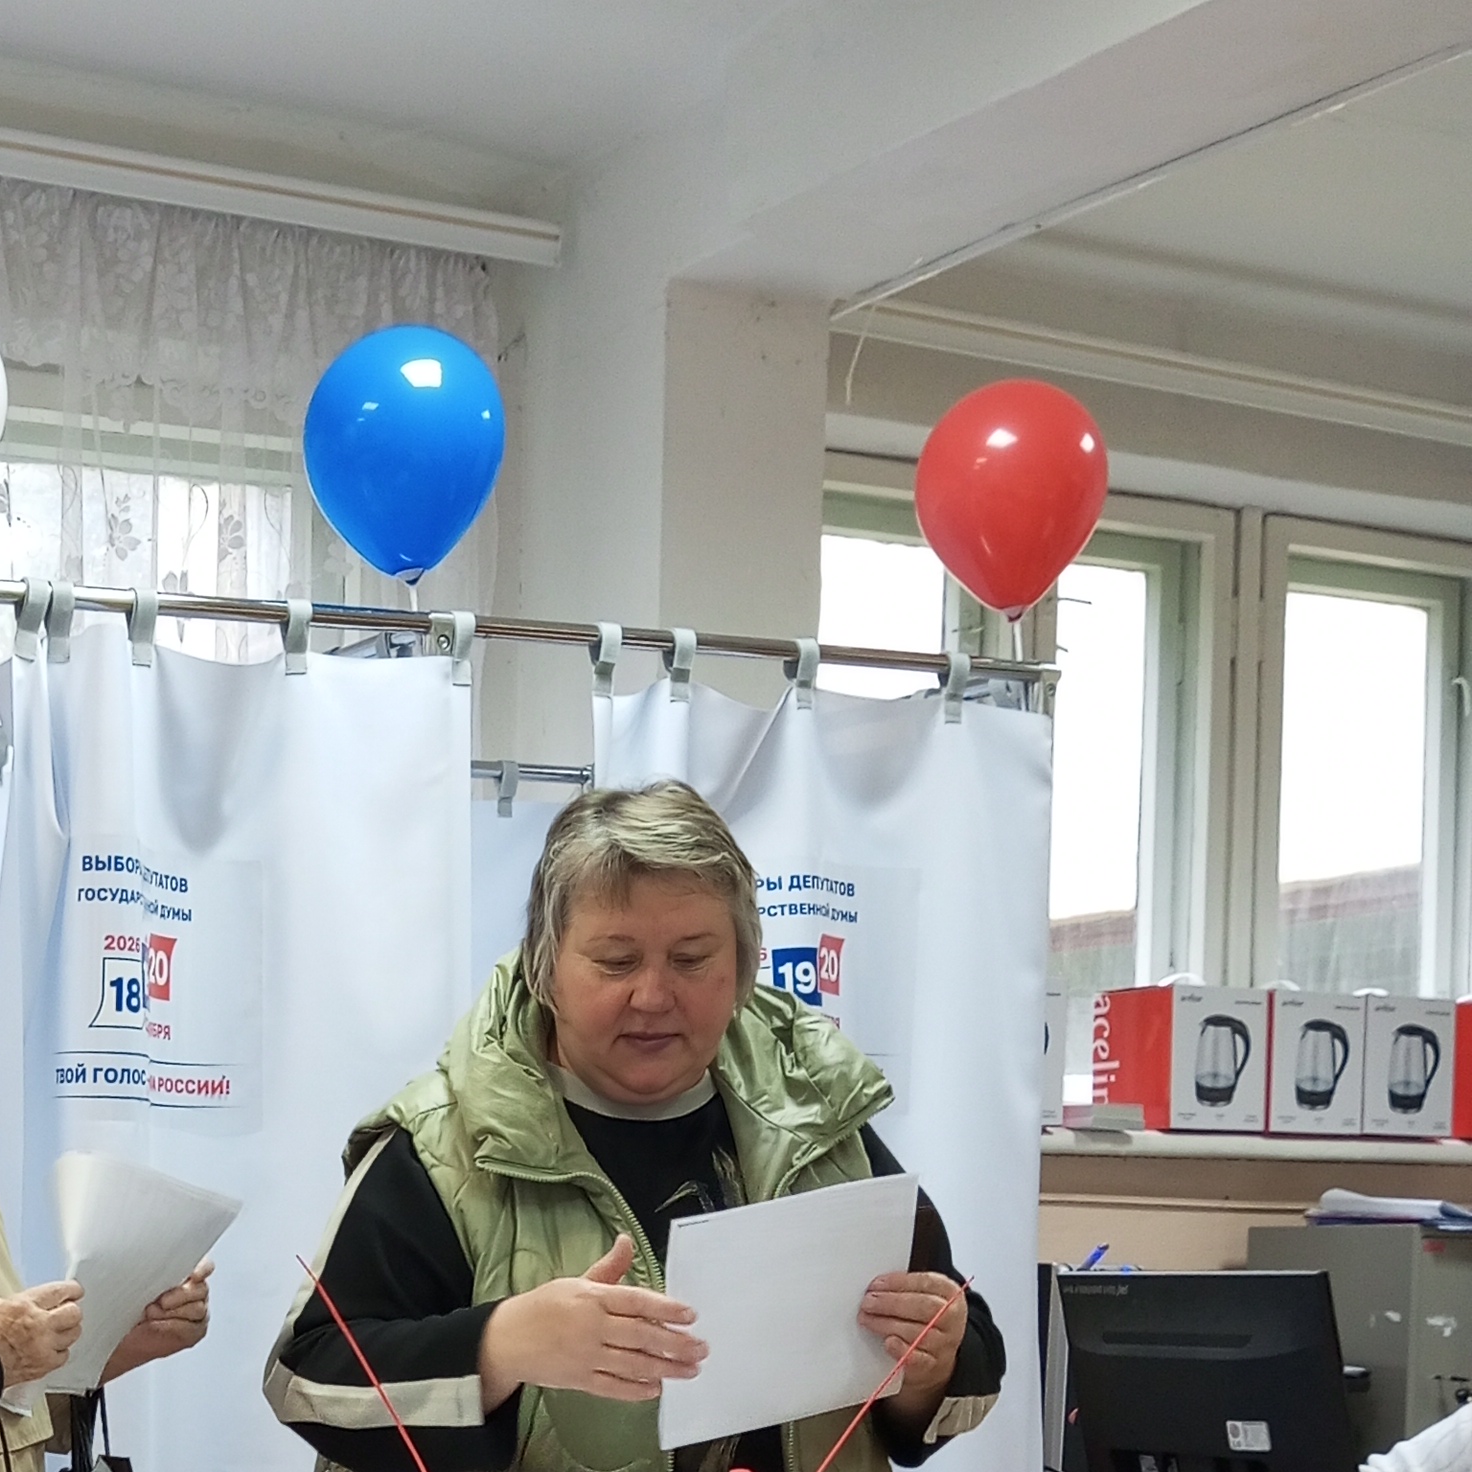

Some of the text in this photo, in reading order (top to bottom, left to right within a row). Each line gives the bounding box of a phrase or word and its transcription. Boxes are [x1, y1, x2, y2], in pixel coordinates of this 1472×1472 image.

[82, 855, 142, 875] ВЫБОР
[788, 875, 855, 897] ДЕПУТАТОВ
[160, 904, 192, 921] ДУМЫ
[831, 908, 858, 924] ДУМЫ
[104, 934, 140, 953] 2026
[148, 947, 168, 986] 20
[778, 961, 816, 994] 19
[819, 947, 838, 982] 20
[110, 977, 140, 1014] 18
[56, 1063, 87, 1084] ТВОЙ
[93, 1067, 146, 1086] ГОЛОС
[158, 1076, 230, 1096] РОССИИ!
